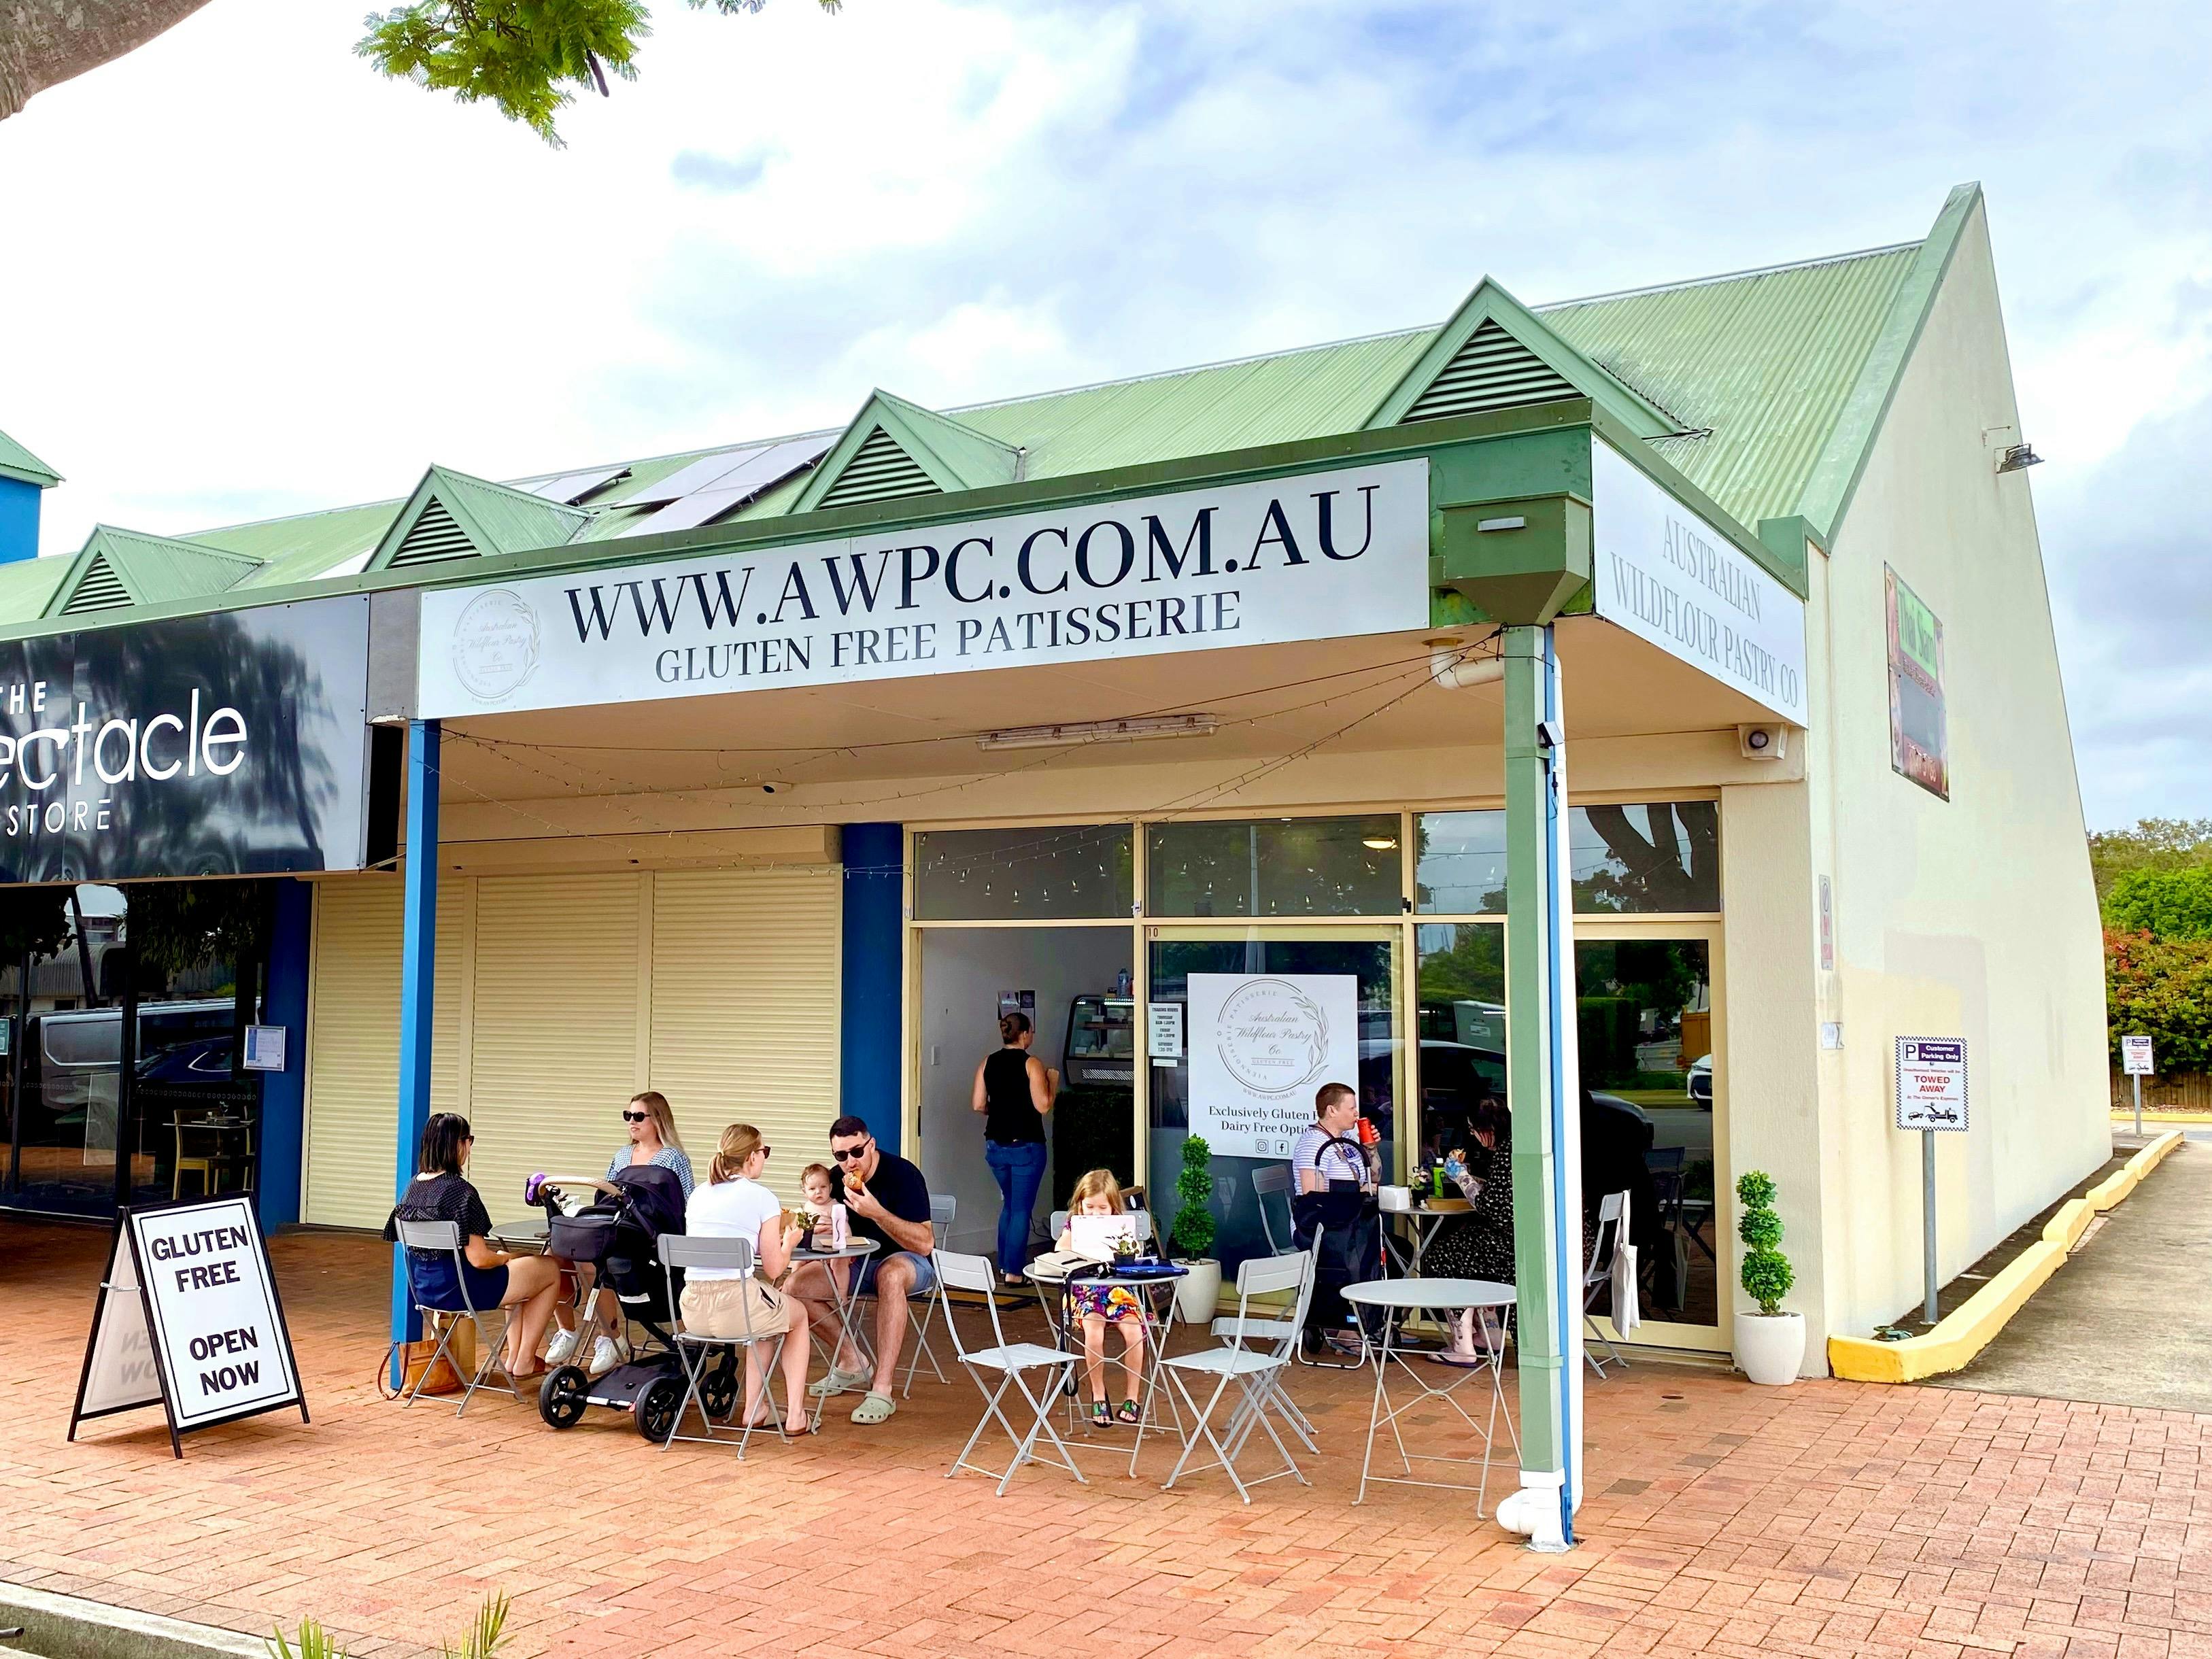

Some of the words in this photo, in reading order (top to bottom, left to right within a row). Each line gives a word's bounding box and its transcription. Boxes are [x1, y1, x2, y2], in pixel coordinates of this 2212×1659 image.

[564, 485, 1380, 643] WWW.AWPC.COM.AU
[1663, 515, 1760, 623] AUSTRALIAN
[656, 636, 811, 683] GLUTEN
[831, 623, 936, 668] FREE
[956, 590, 1241, 656] PATISSERIE
[1610, 551, 1719, 663] WILDFLOUR
[1724, 625, 1775, 696] PASTRY
[1781, 664, 1797, 707] CO
[0, 681, 46, 715] HE
[6, 798, 110, 836] STORE
[1148, 927, 1158, 938] 10
[1249, 1010, 1299, 1023] Australian
[1268, 1044, 1281, 1055] Co
[1279, 1029, 1312, 1044] Pastry
[1921, 1053, 1944, 1061] Parking
[1914, 1076, 1950, 1084] TOWED
[1209, 1106, 1269, 1121] Exclusively
[1272, 1109, 1310, 1121] Gluten
[1221, 1121, 1251, 1133] Dairy
[1253, 1123, 1278, 1133] Free
[151, 1225, 248, 1262] GLUTEN
[175, 1261, 240, 1293] FREE
[190, 1326, 258, 1361] OPEN
[200, 1361, 259, 1396] NOW
